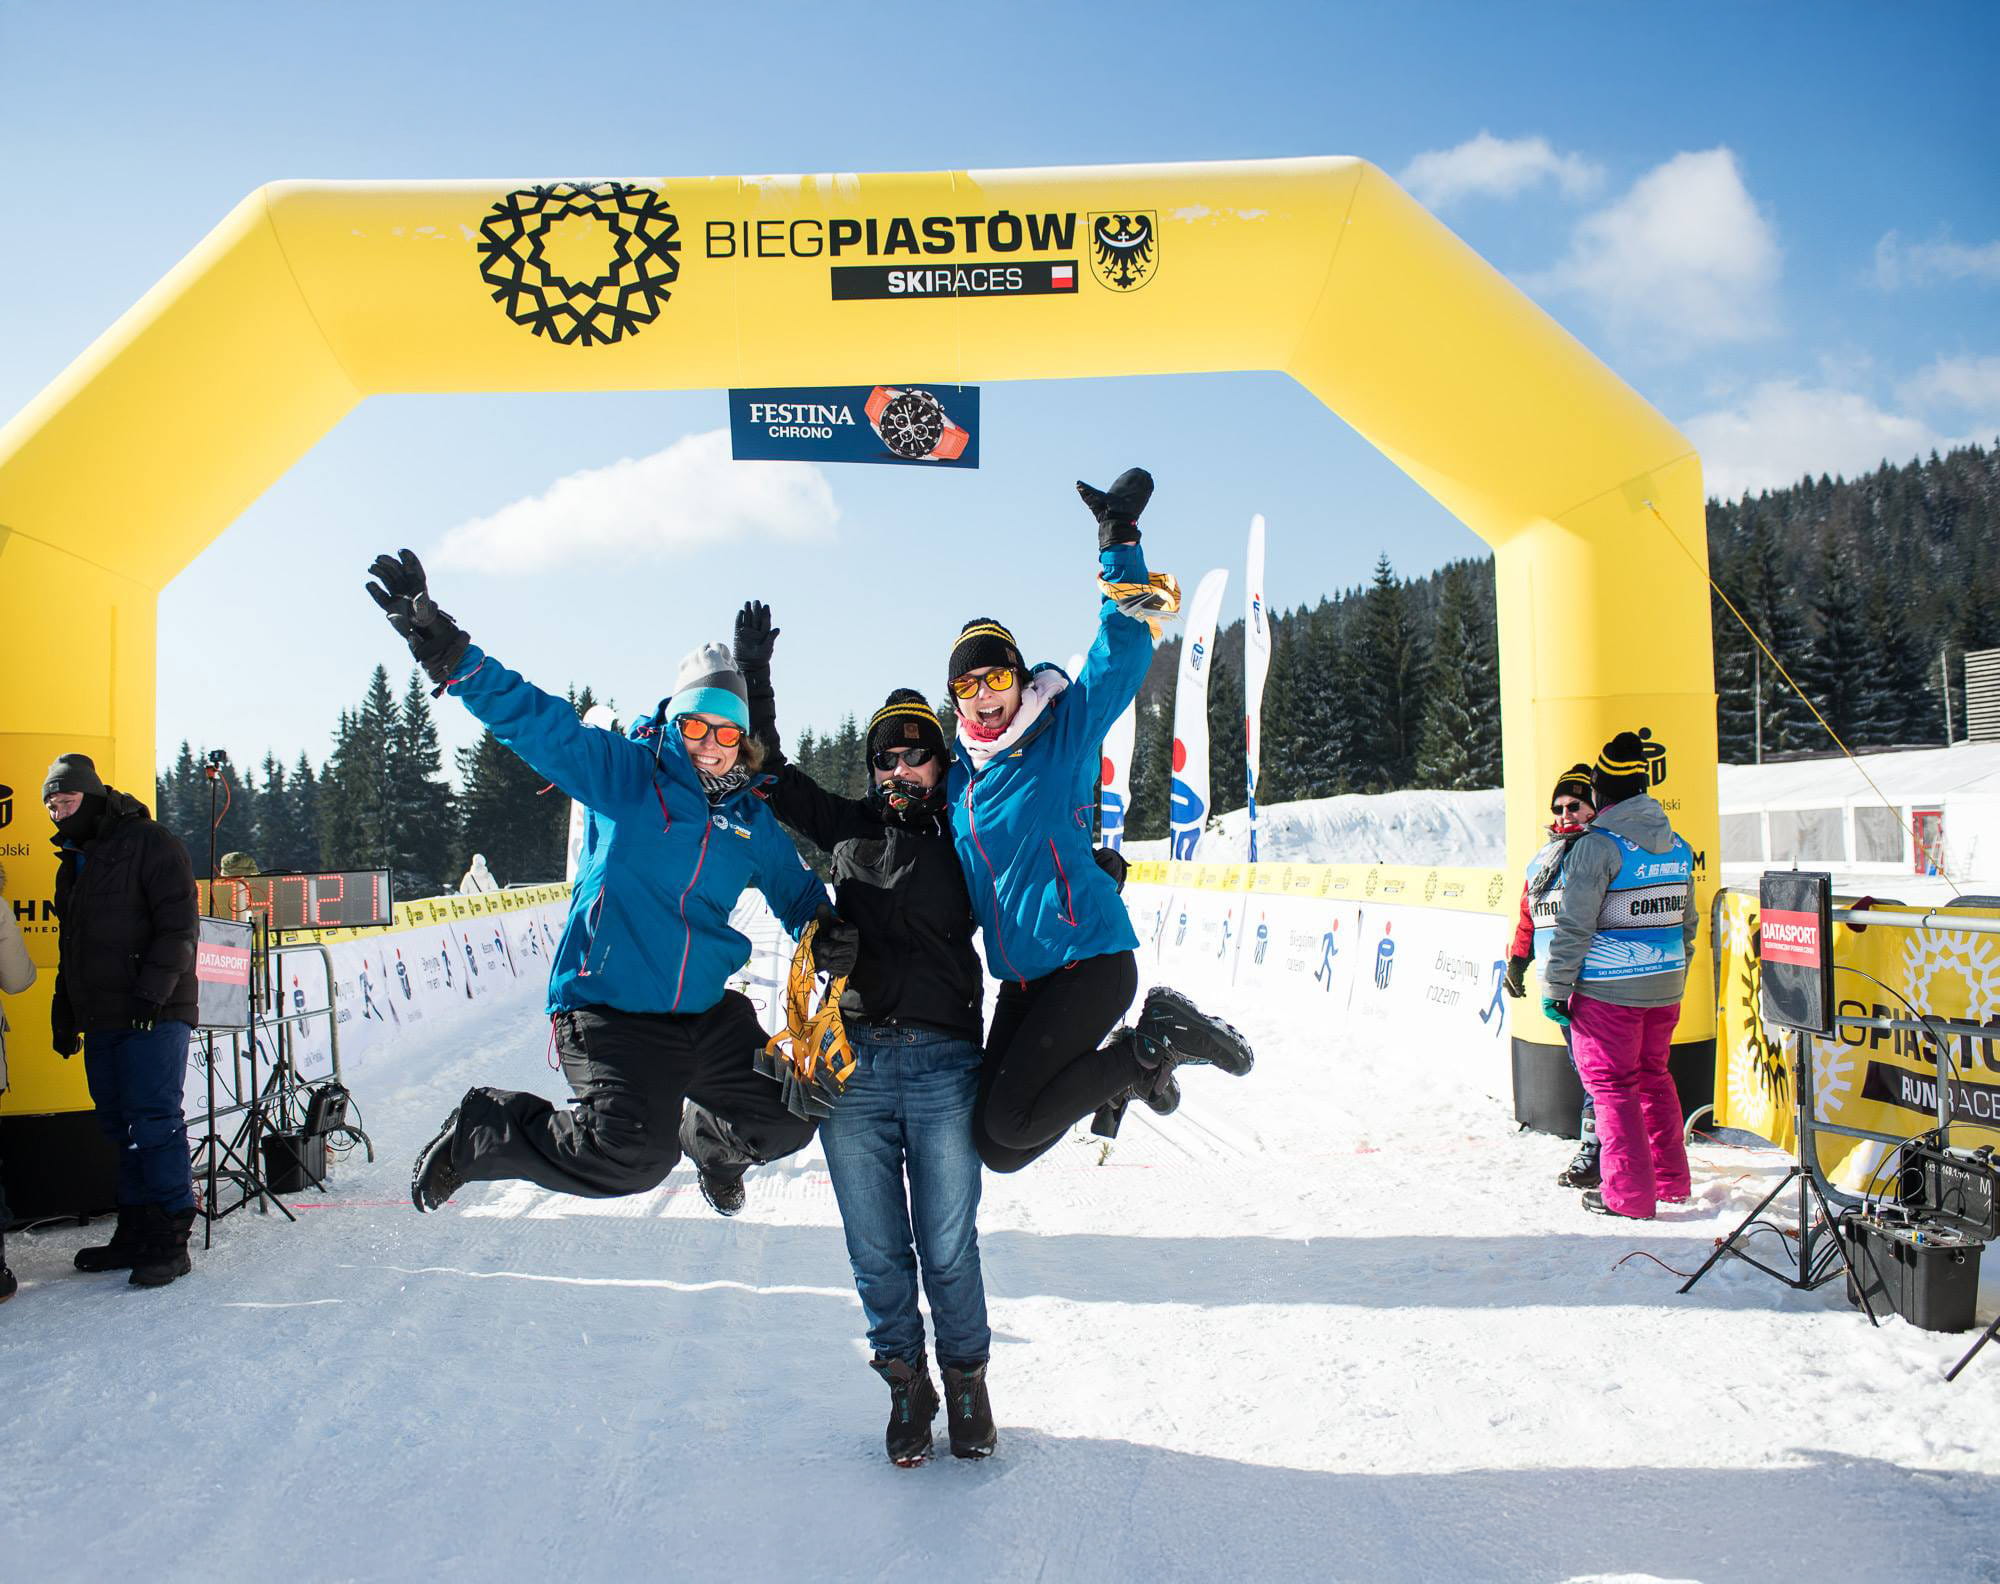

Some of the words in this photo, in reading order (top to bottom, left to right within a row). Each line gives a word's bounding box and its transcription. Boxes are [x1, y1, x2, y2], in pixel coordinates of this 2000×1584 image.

[887, 267, 1024, 293] SKIRACES
[749, 403, 856, 426] FESTINA
[768, 425, 833, 439] CHRONO
[1762, 922, 1817, 944] DATASPORT
[199, 952, 248, 971] DATASPORT
